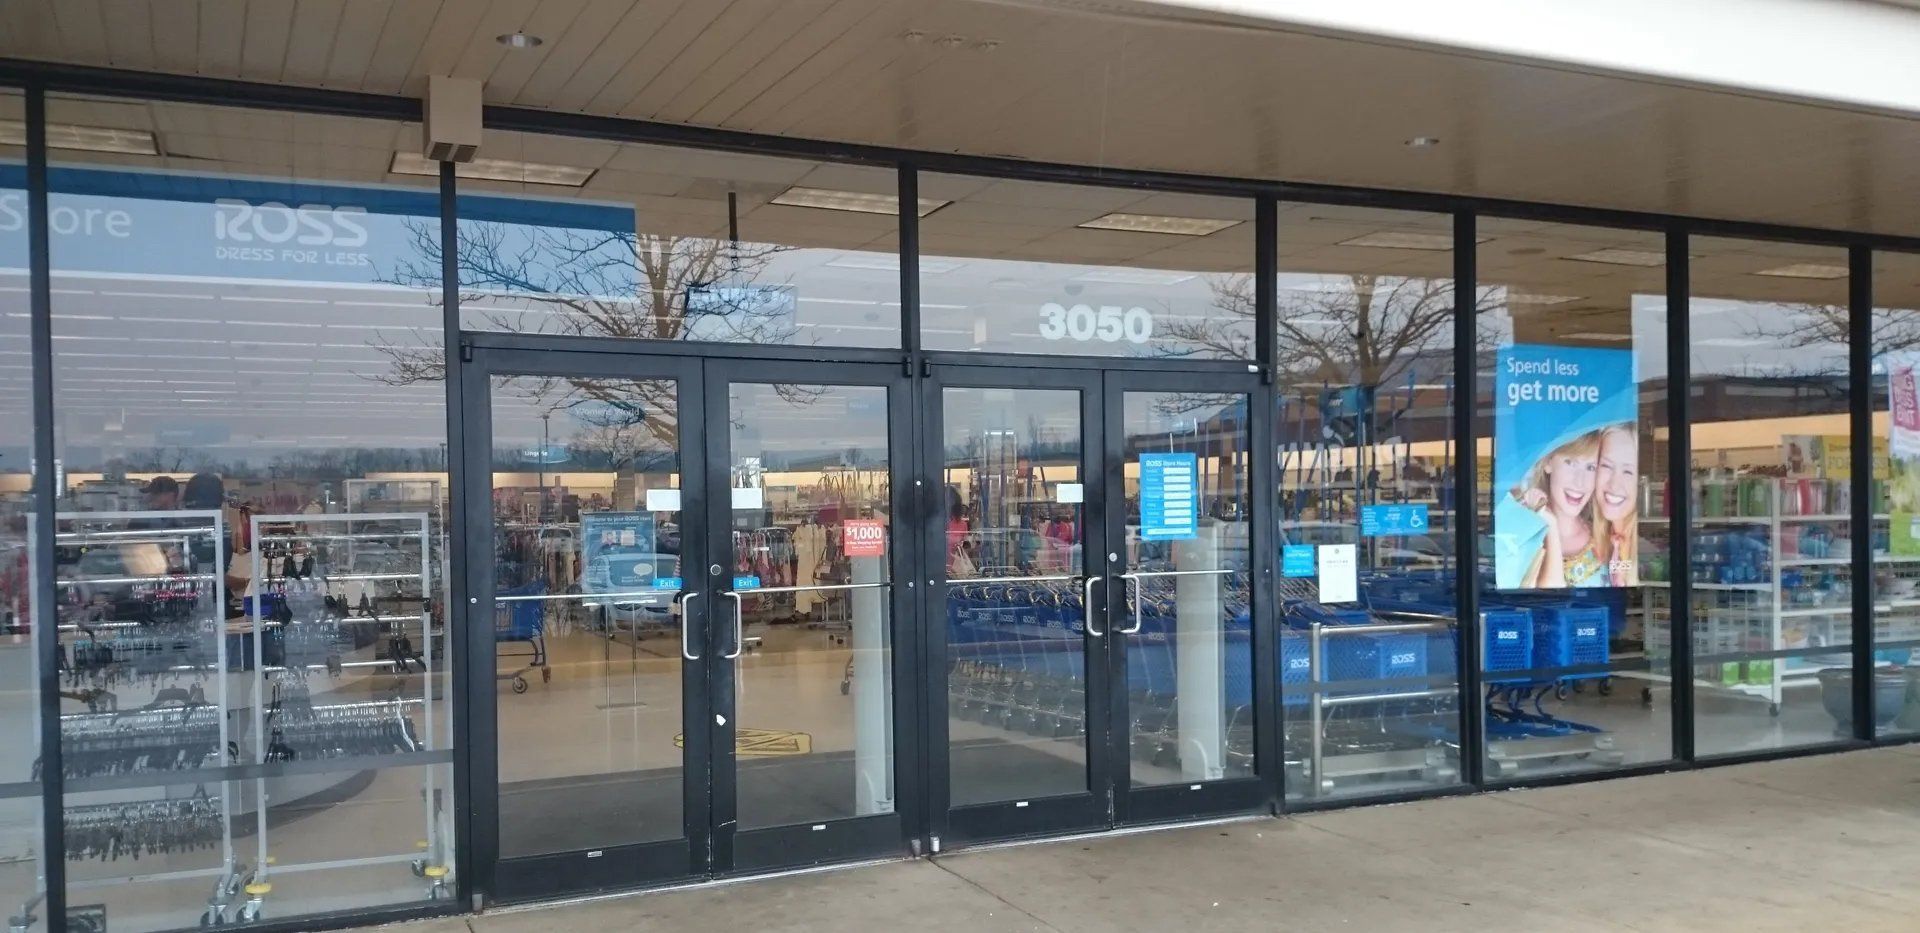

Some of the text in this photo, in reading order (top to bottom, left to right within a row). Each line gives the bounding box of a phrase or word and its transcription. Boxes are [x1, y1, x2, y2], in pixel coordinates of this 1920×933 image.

[0, 194, 131, 237] Sore
[215, 198, 368, 247] ROSS
[215, 247, 370, 266] DRESS FOR LESS
[1039, 303, 1153, 343] 3050
[1507, 357, 1579, 375] Spend less
[1508, 380, 1599, 406] get more
[846, 526, 882, 541] $1,000
[660, 579, 674, 587] Exit
[739, 579, 752, 587] Exit
[1497, 631, 1518, 639] ROSS
[1577, 628, 1596, 636] ROSS
[1291, 658, 1309, 668] ROS
[1391, 653, 1414, 664] ROSS
